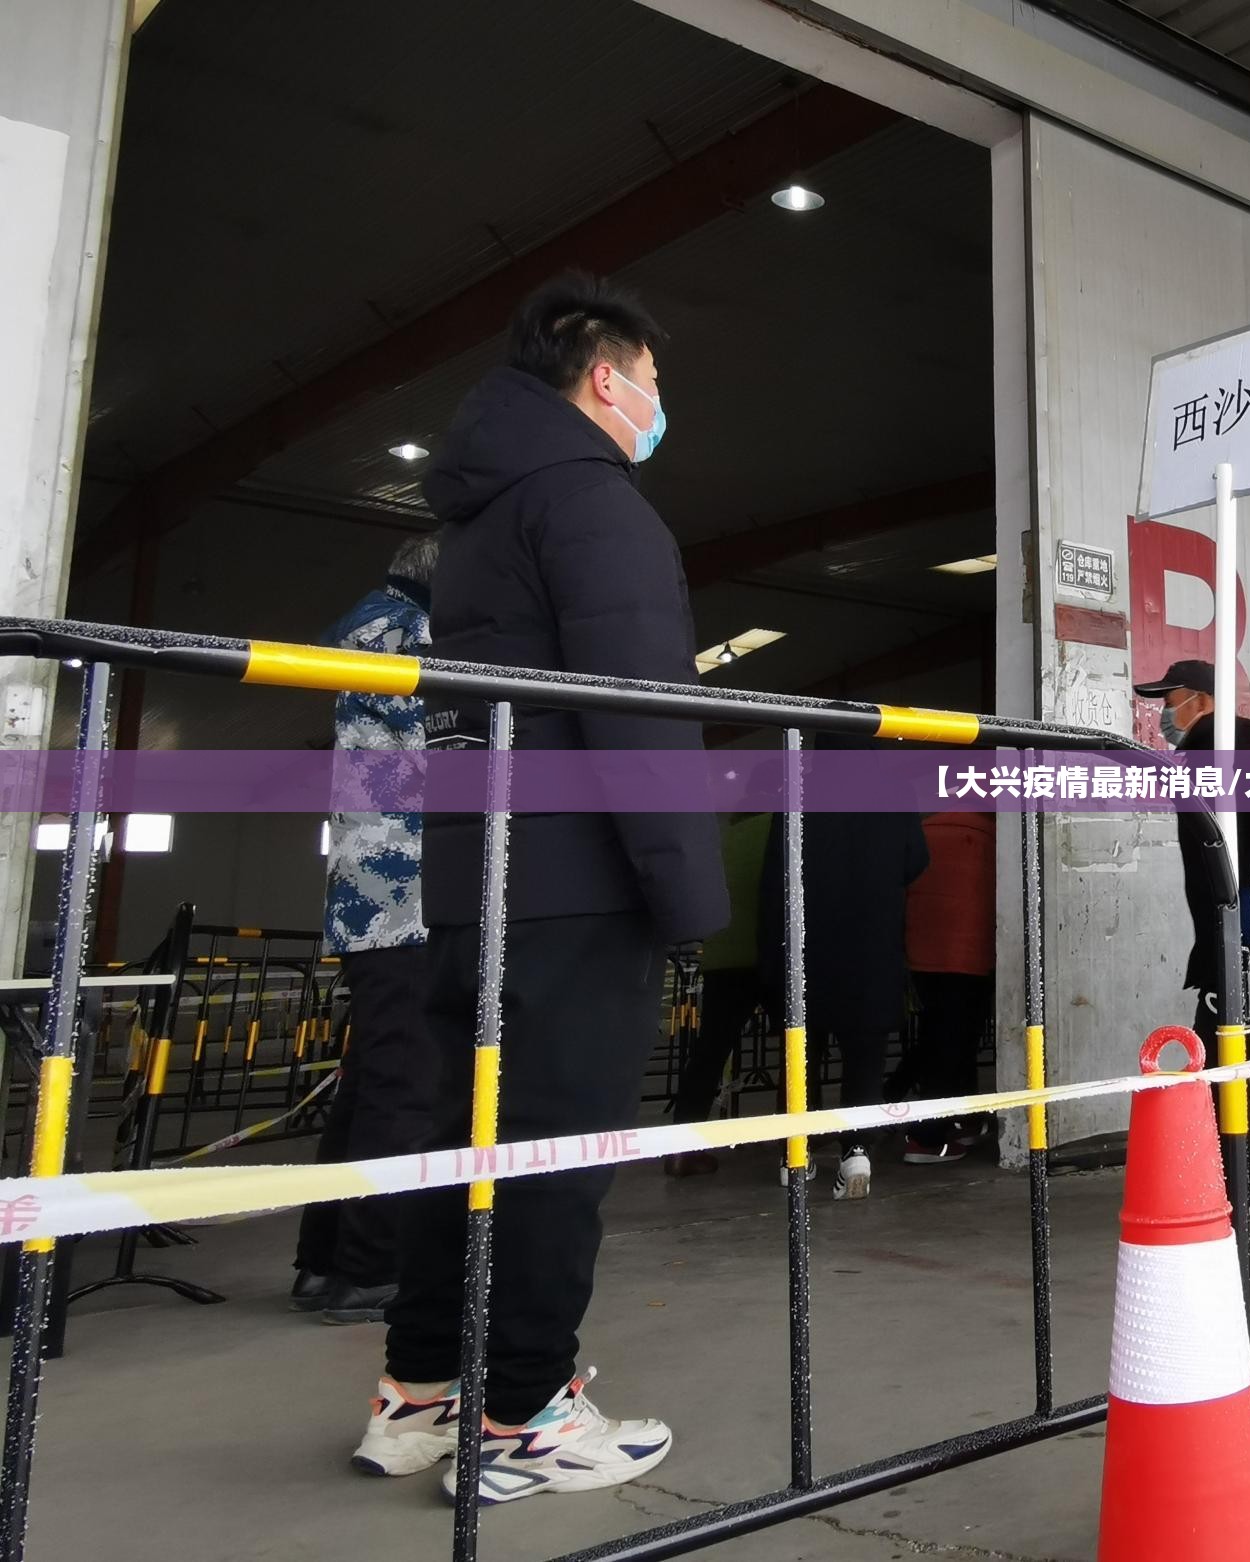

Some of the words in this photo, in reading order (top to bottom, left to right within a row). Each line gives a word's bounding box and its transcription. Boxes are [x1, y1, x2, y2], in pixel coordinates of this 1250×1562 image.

[1077, 554, 1108, 573] 仓库重地
[1062, 572, 1074, 583] 119
[1077, 569, 1109, 588] 严禁烟火
